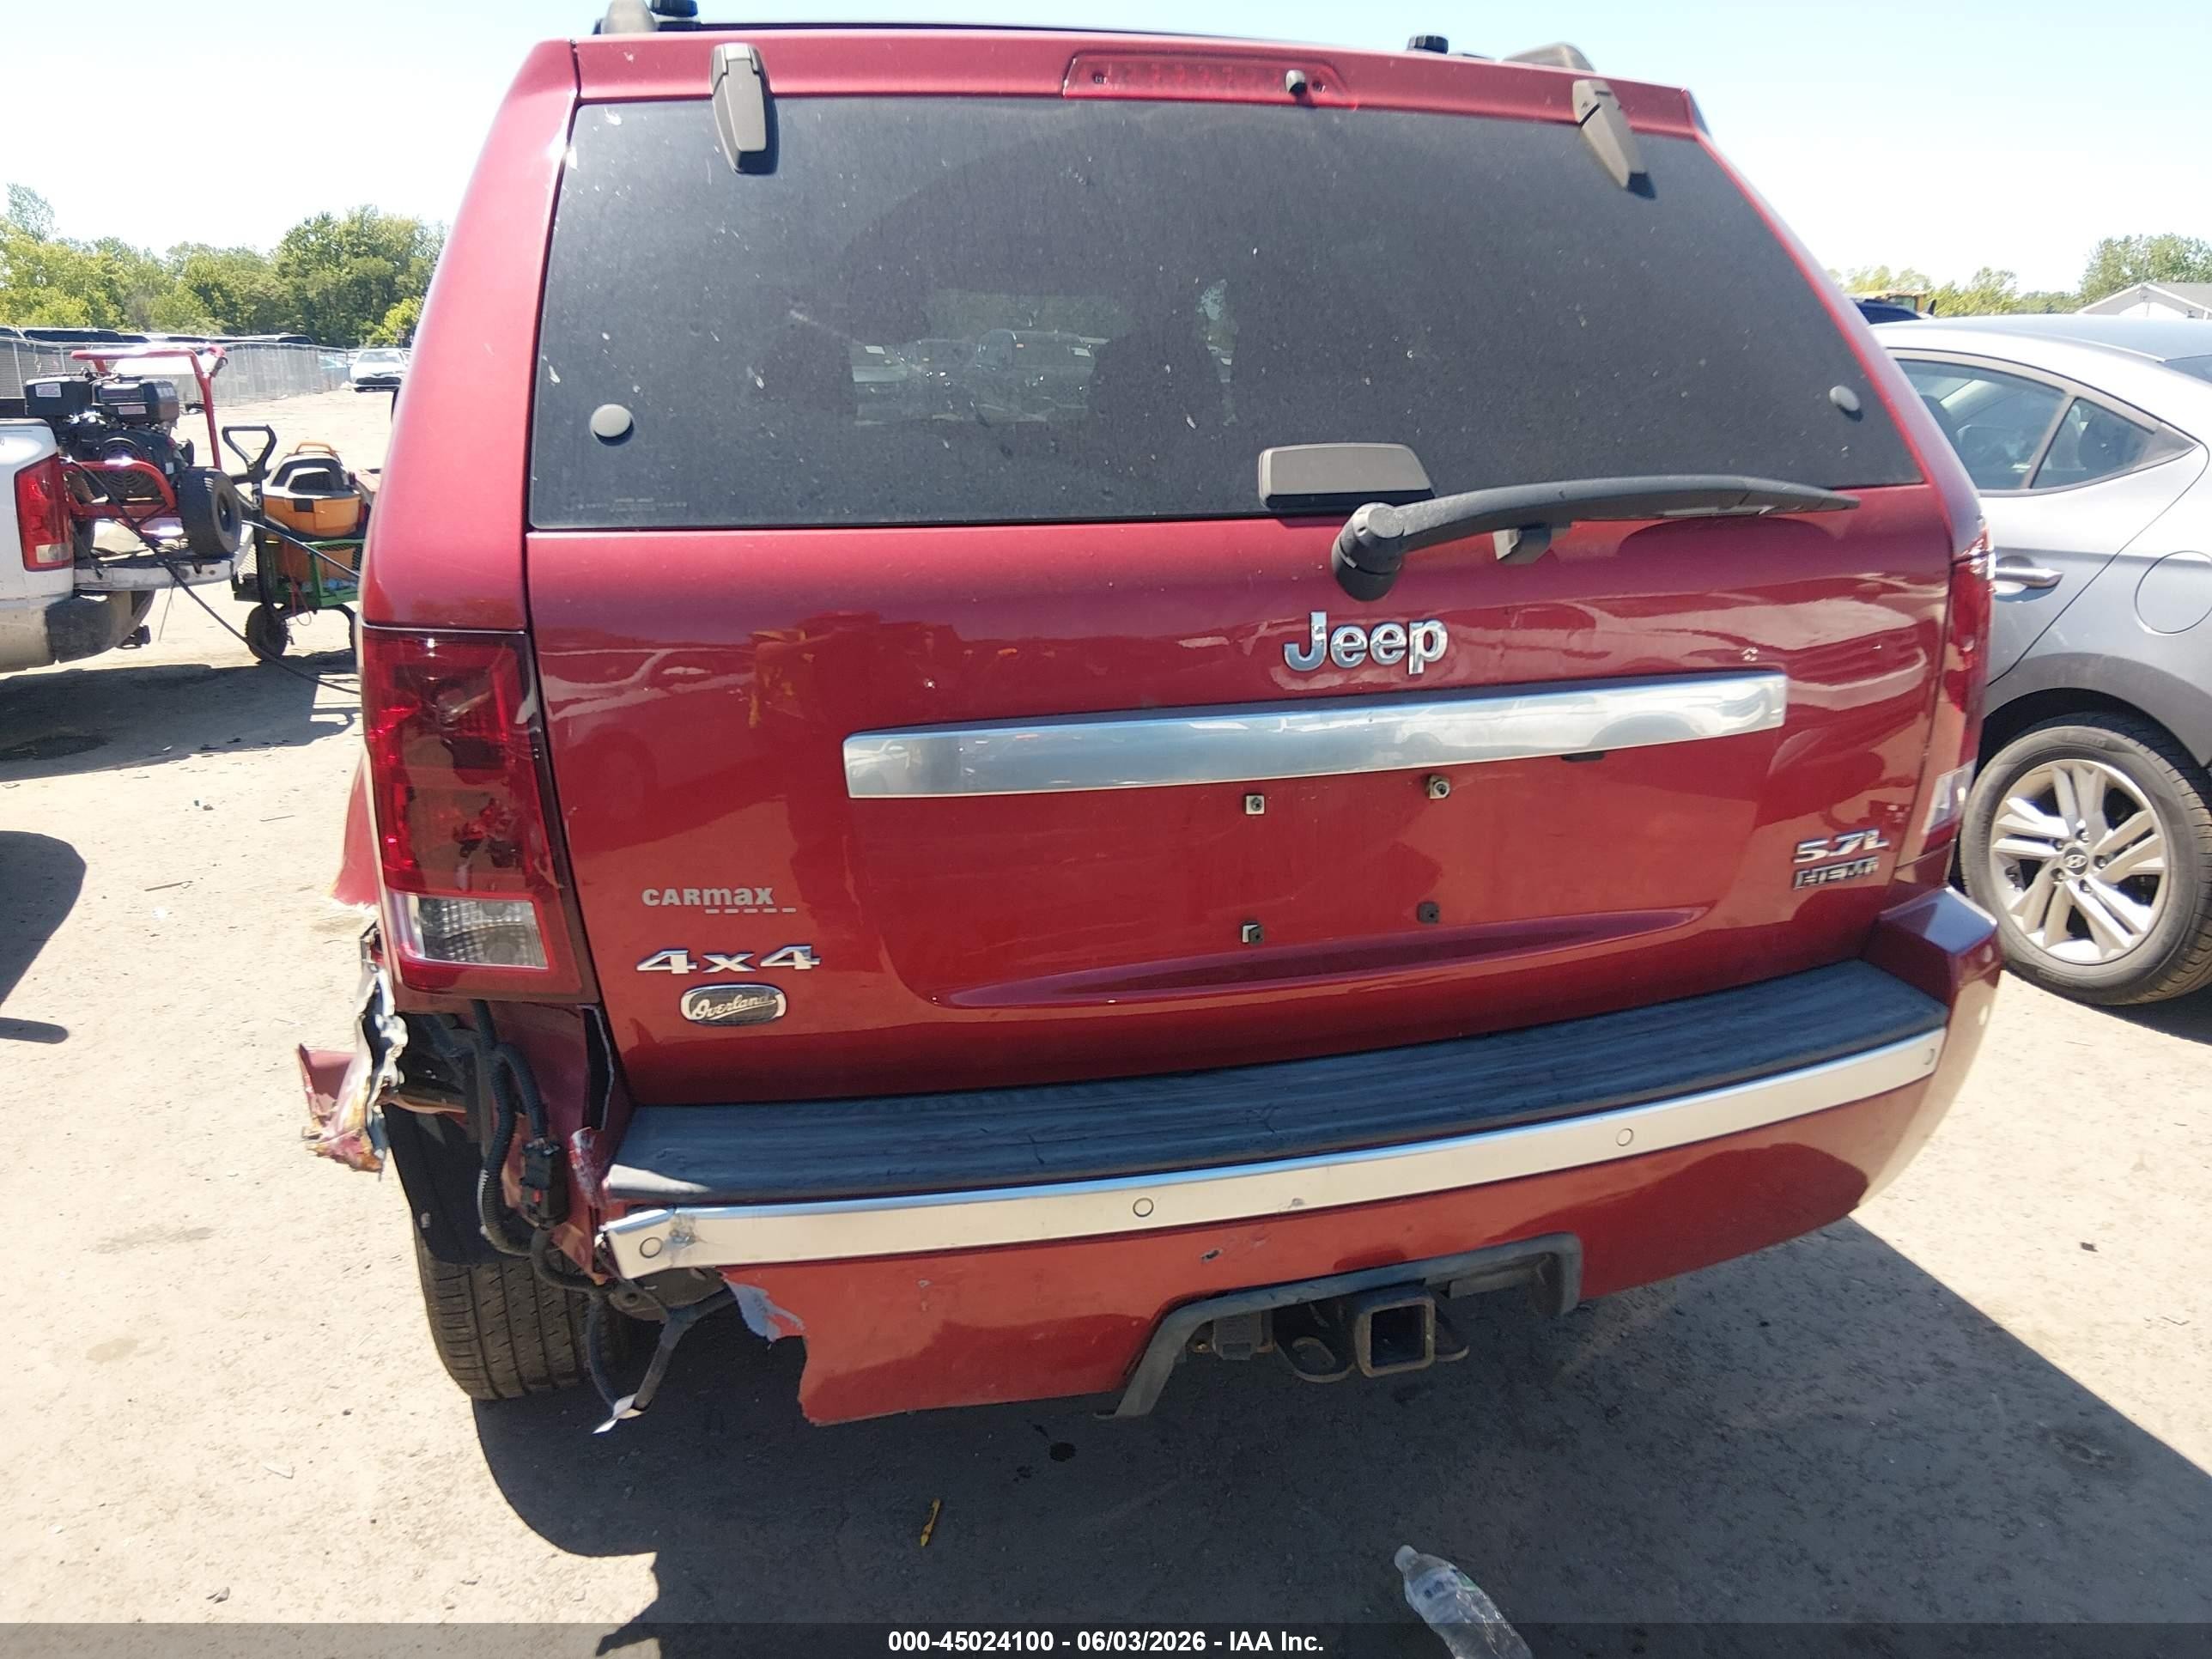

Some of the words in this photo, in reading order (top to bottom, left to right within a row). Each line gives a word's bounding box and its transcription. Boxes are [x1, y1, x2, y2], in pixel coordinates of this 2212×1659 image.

[1283, 611, 1449, 675] Jeep
[1792, 827, 1890, 864] 5.7L
[641, 887, 775, 907] CARmax
[635, 945, 822, 975] 4x4
